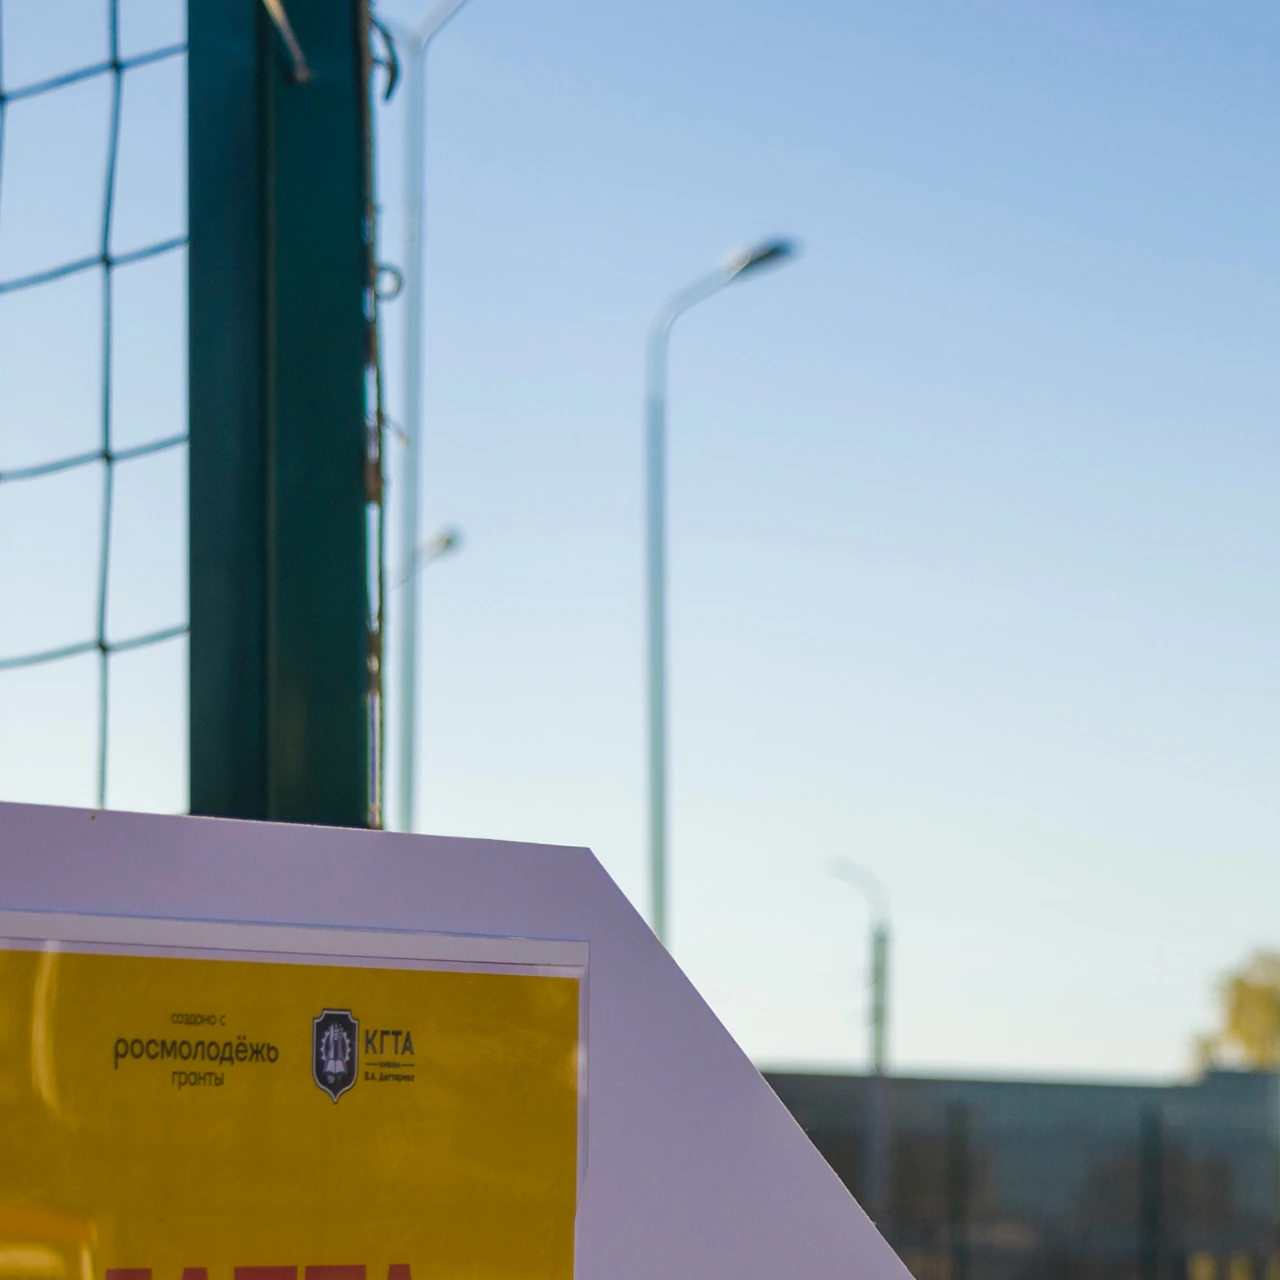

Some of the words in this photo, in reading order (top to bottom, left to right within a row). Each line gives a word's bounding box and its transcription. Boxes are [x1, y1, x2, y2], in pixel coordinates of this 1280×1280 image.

[171, 1013, 217, 1026] создано
[219, 1015, 226, 1026] с
[113, 1035, 279, 1070] росмолодёжь
[365, 1029, 415, 1056] КГТА
[171, 1071, 225, 1091] гранты
